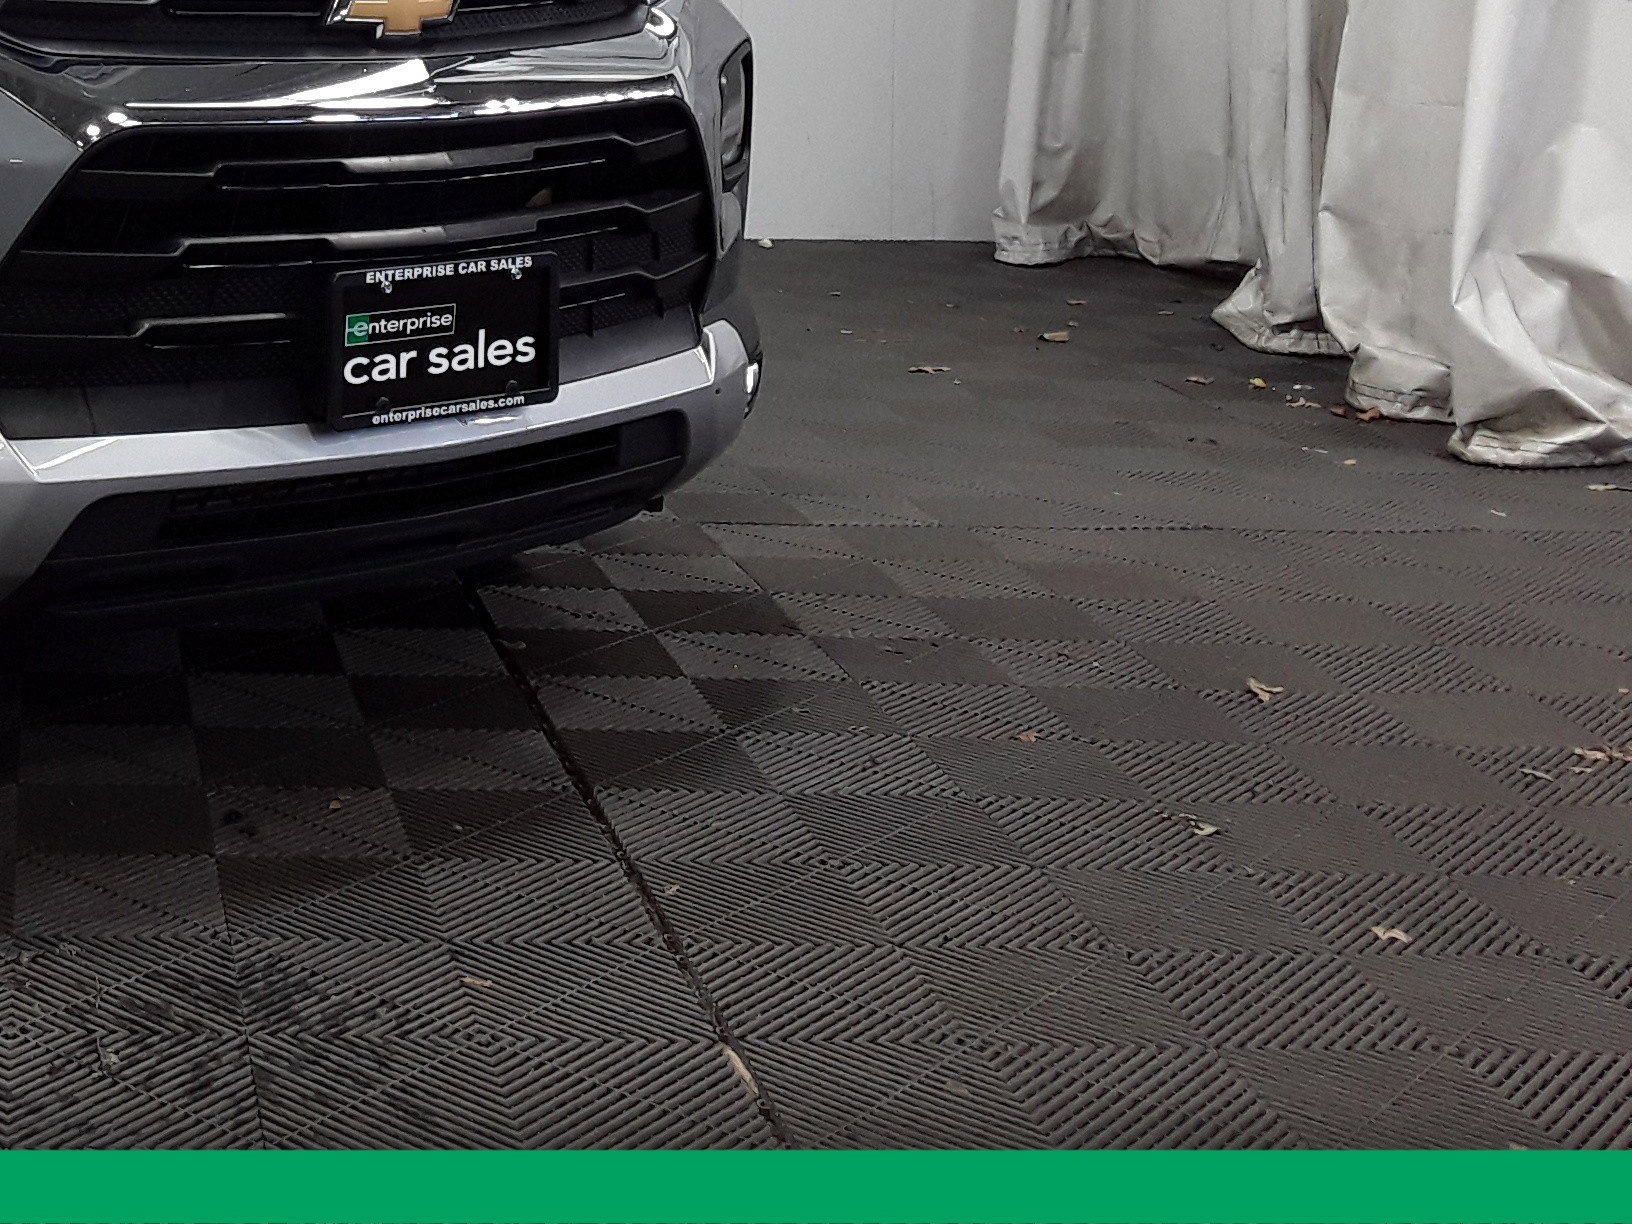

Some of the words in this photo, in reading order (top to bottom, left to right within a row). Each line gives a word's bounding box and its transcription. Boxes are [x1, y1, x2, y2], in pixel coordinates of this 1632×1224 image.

[366, 263, 455, 284] ENTERPRISE
[458, 260, 487, 274] CAR
[490, 256, 533, 271] SALES
[349, 312, 453, 337] enterprise
[343, 349, 418, 385] car
[427, 328, 536, 375] sales
[372, 395, 525, 425] enterprisecarsales.com
